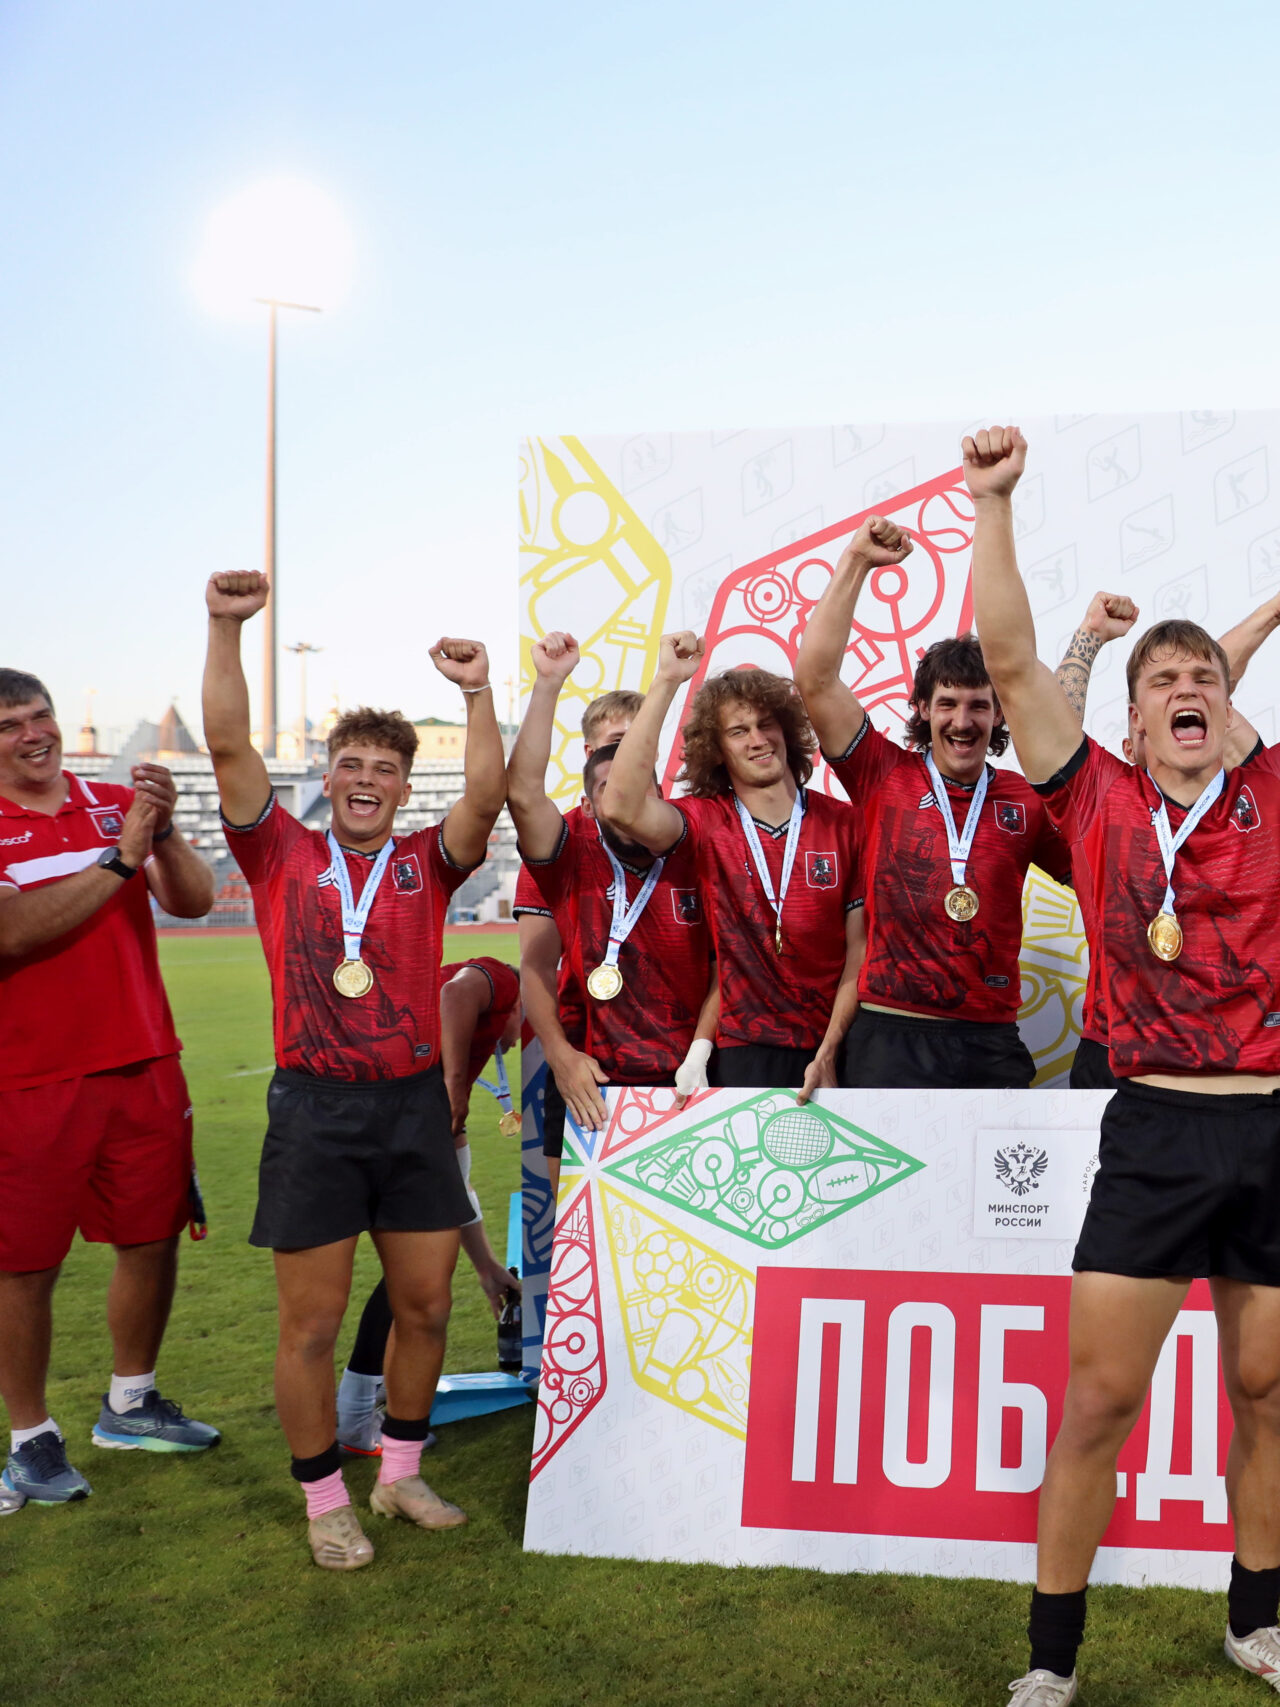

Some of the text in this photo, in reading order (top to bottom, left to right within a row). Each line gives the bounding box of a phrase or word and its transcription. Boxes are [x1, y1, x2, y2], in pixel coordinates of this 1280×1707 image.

[1082, 1154, 1099, 1193] НАРОДО
[988, 1203, 1050, 1214] МИНСПОРТ
[995, 1217, 1042, 1228] РОССИИ
